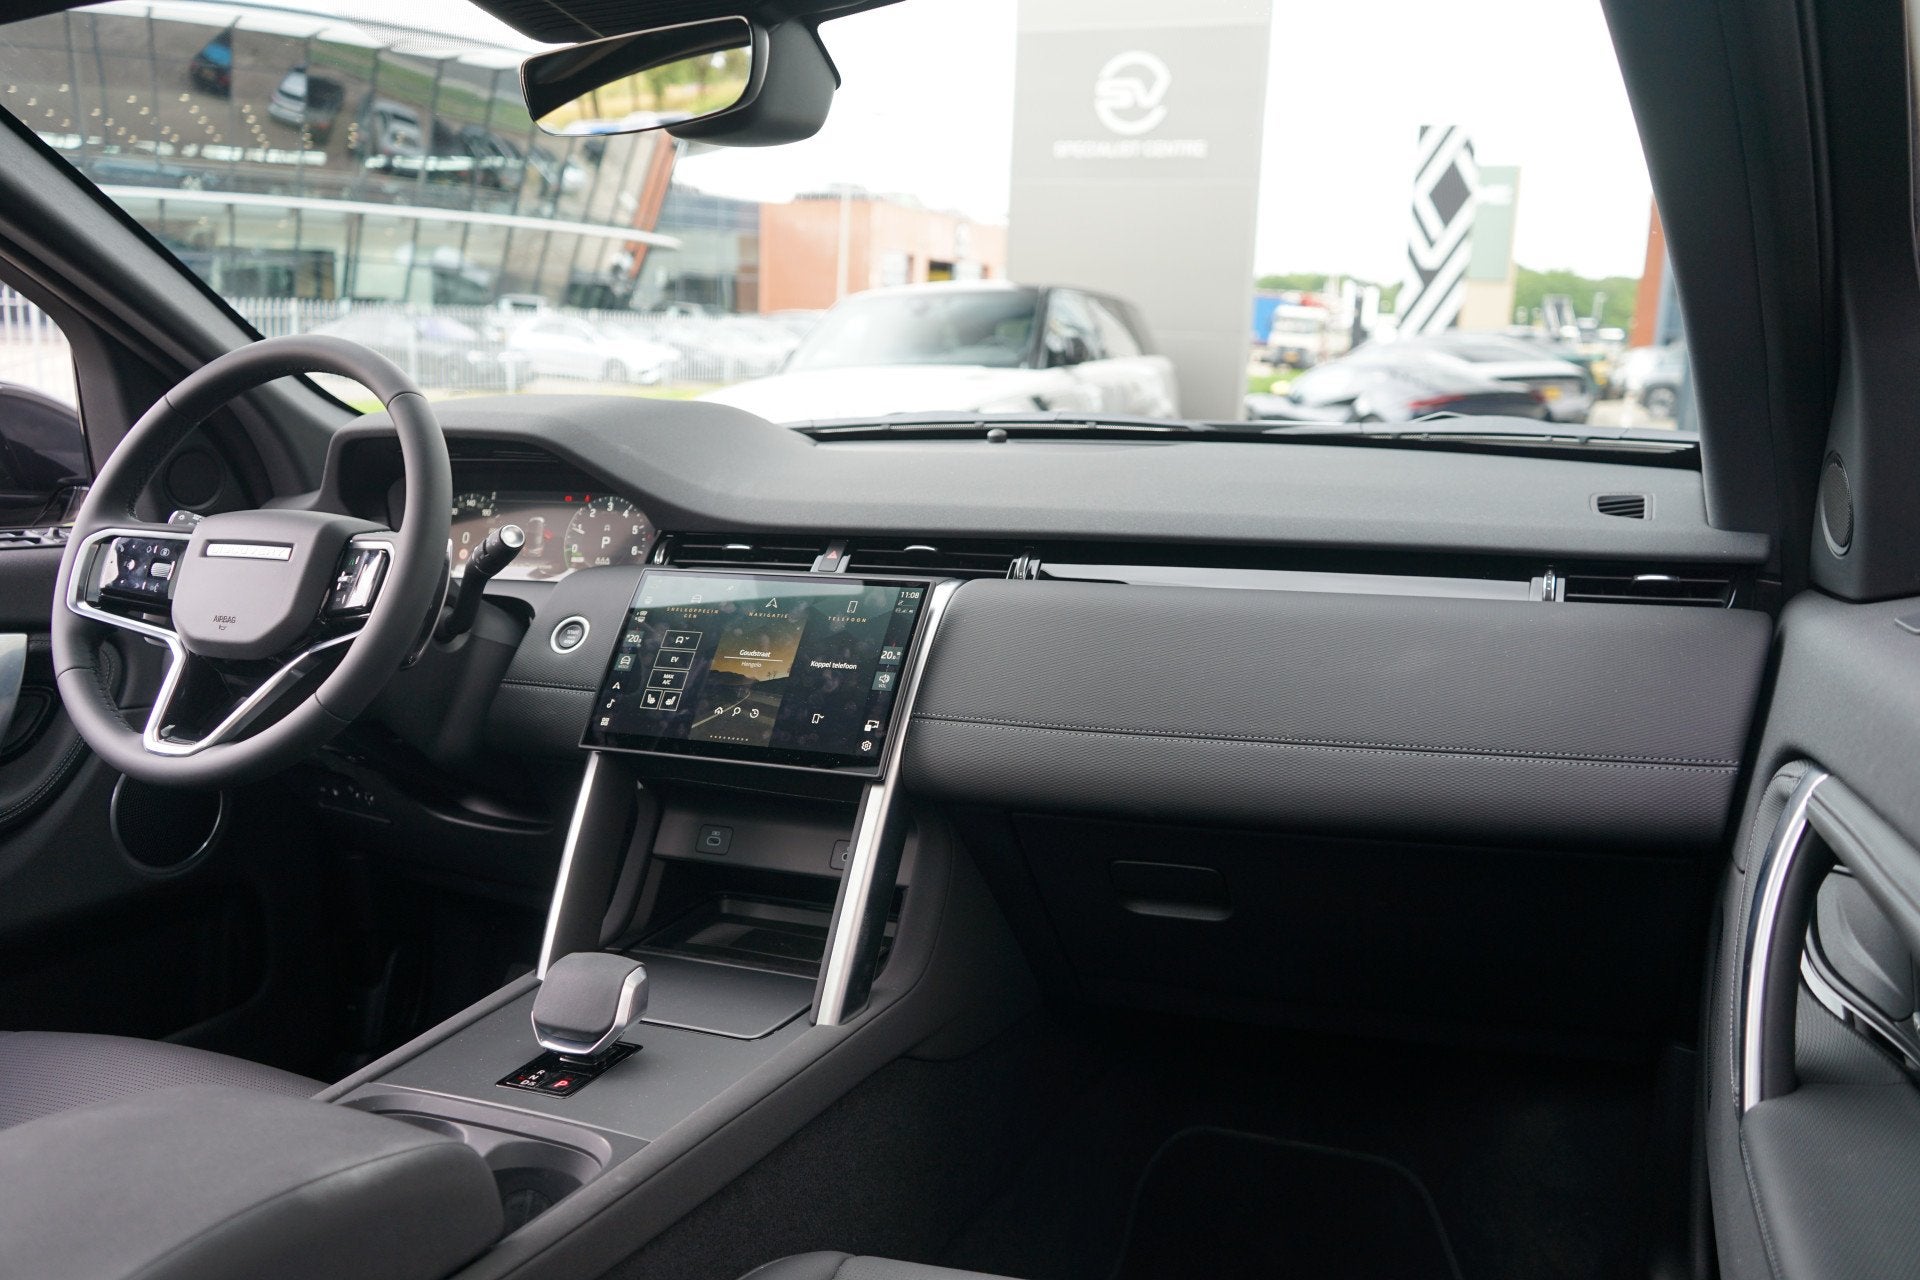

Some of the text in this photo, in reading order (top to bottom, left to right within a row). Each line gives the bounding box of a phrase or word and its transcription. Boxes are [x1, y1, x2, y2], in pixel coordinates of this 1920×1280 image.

[1141, 138, 1208, 159] CENTRE
[607, 501, 614, 511] 3
[589, 508, 597, 518] 2
[622, 509, 629, 518] 4
[632, 525, 639, 535] 5
[462, 531, 470, 544] 0
[601, 536, 611, 549] P
[571, 543, 578, 553] 0
[631, 545, 638, 556] 6
[900, 591, 920, 599] 11:08
[212, 614, 237, 624] AIRBAG
[748, 611, 789, 619] NAVIGATIE
[810, 660, 857, 670] Koppel telefoon
